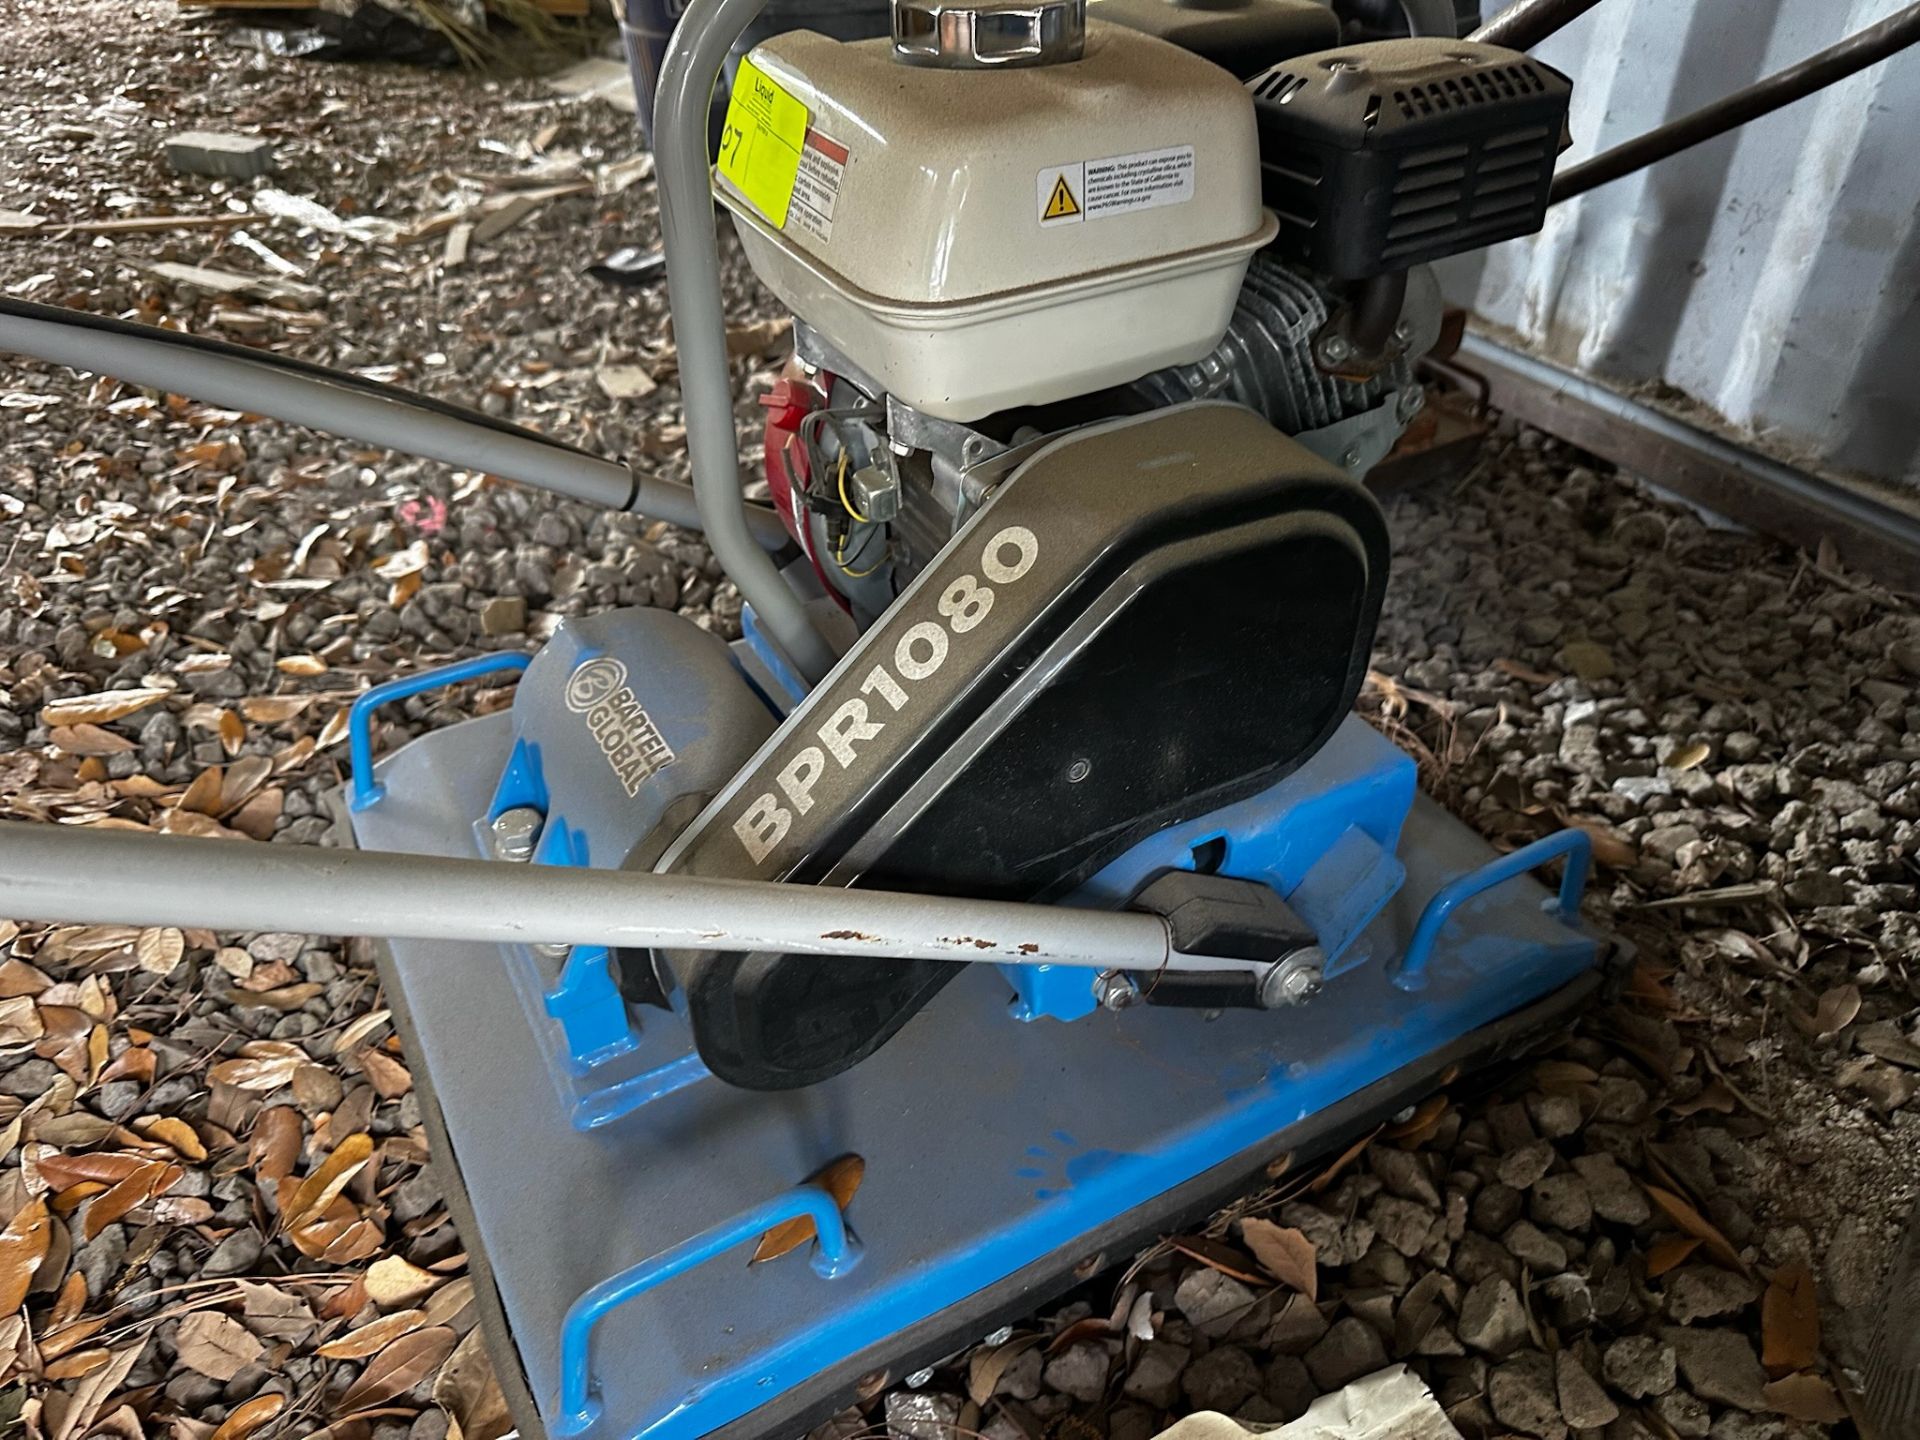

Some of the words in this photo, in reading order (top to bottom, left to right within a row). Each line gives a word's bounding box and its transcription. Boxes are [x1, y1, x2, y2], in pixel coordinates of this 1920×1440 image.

[755, 77, 775, 105] Liquid
[1088, 166, 1116, 176] WARNING:
[1128, 160, 1148, 169] product
[1088, 176, 1113, 184] chemicals
[1113, 172, 1137, 180] including
[1137, 167, 1163, 176] crystalline
[1176, 161, 1192, 169] which
[1097, 184, 1114, 192] known
[1144, 176, 1150, 184] of
[1150, 174, 1174, 182] California
[1144, 184, 1173, 192] information
[732, 526, 1039, 865] BPR1080
[607, 688, 673, 774] BARTELL
[588, 705, 650, 794] GLOBAL
